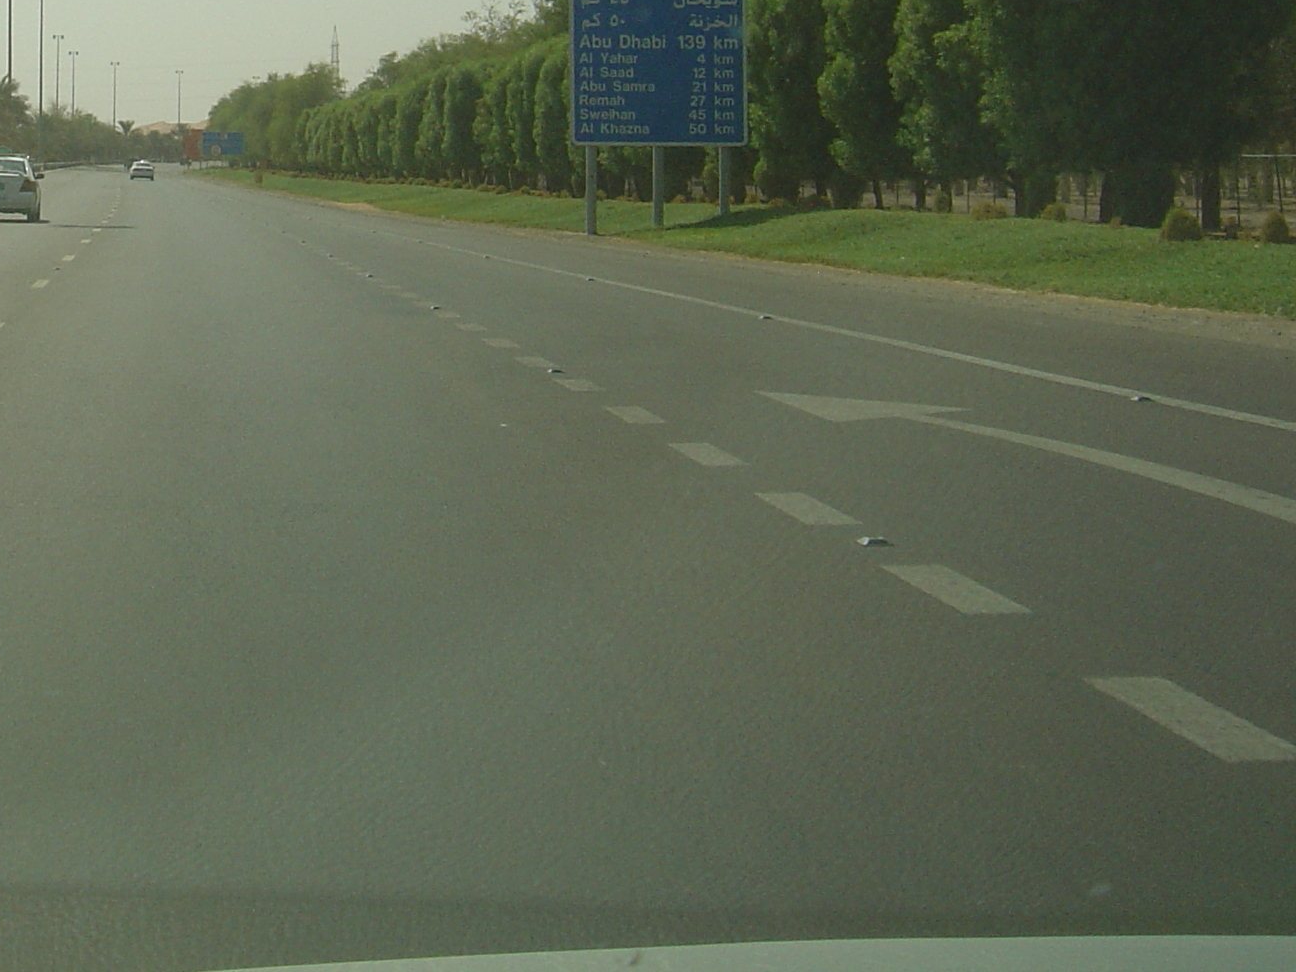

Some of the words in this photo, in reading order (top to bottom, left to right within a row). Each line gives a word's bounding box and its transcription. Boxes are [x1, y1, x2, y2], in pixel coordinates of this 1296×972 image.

[581, 13, 601, 32] كم
[579, 34, 612, 49] Abu
[619, 34, 666, 49] Dhabi
[678, 34, 706, 50] 139
[713, 35, 739, 49] km
[579, 53, 593, 64] Al
[600, 53, 638, 64] Yahar
[697, 54, 706, 64] 4
[714, 54, 734, 64] km
[579, 67, 593, 78] Al
[600, 67, 634, 78] Saad
[693, 67, 706, 78] 12
[714, 68, 734, 78] km
[579, 81, 606, 92] Abu
[613, 81, 655, 92] Samra
[693, 82, 706, 93] 21
[714, 81, 734, 92] km
[579, 95, 625, 106] Remah
[690, 95, 706, 107] 27
[714, 96, 734, 106] km
[579, 108, 636, 120] Sweihan
[688, 109, 706, 120] 45
[714, 109, 734, 120] km
[580, 123, 593, 134] Al
[600, 123, 650, 134] Khazna
[689, 123, 707, 134] 50
[714, 124, 734, 134] km
